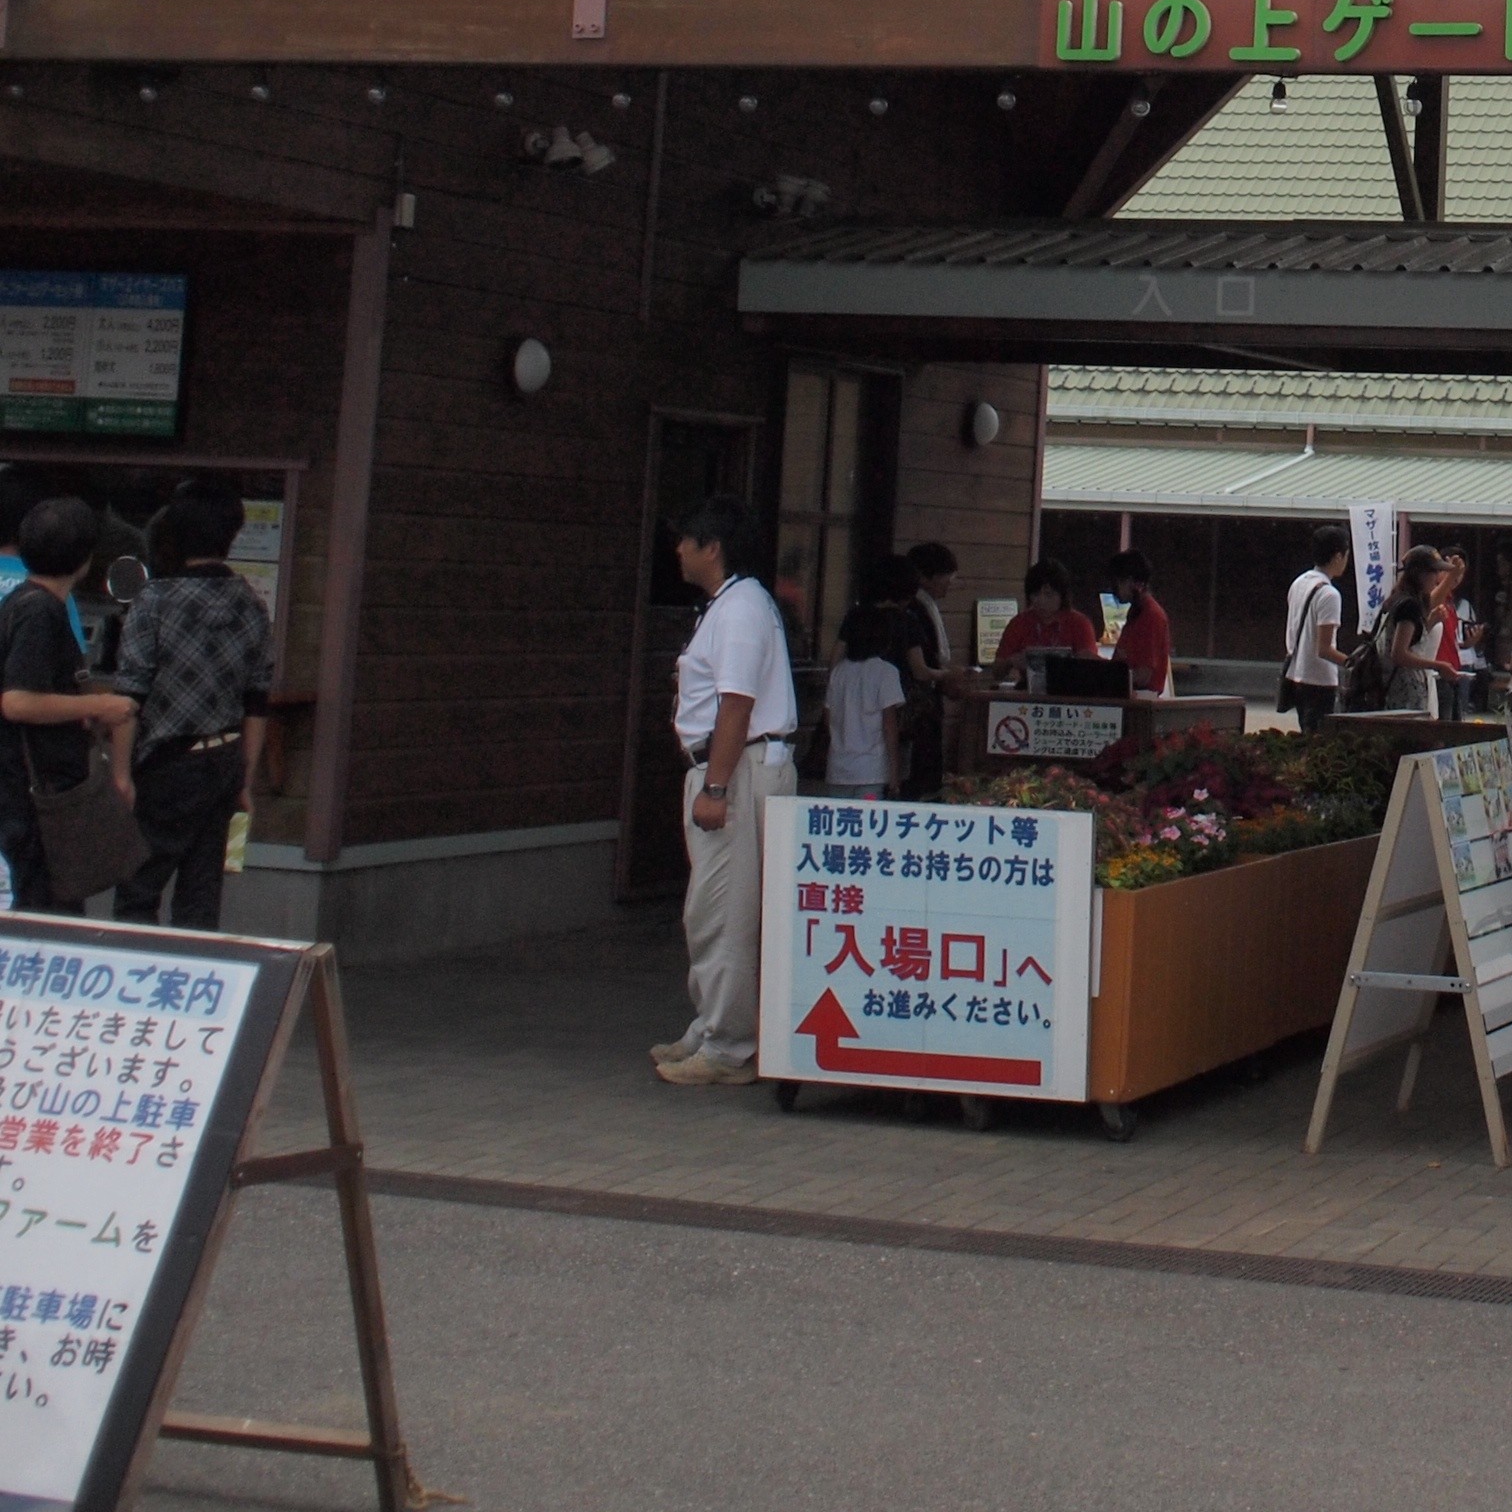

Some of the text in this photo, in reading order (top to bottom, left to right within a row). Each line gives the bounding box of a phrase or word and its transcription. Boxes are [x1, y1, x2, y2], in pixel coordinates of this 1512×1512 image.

[1131, 274, 1256, 317] 入口
[807, 804, 1039, 848] 前売りチケット等
[796, 843, 1055, 886] 入場券をお持ちの方は
[796, 882, 865, 915] 直接
[805, 918, 1053, 988] 「入場口」へ
[0, 948, 225, 1015] 時間のご案内
[0, 999, 225, 1055] いただきまして
[862, 988, 1053, 1029] お進みください。
[0, 1076, 201, 1132] び山の上駐車
[0, 1114, 184, 1168] 営業を終了さ
